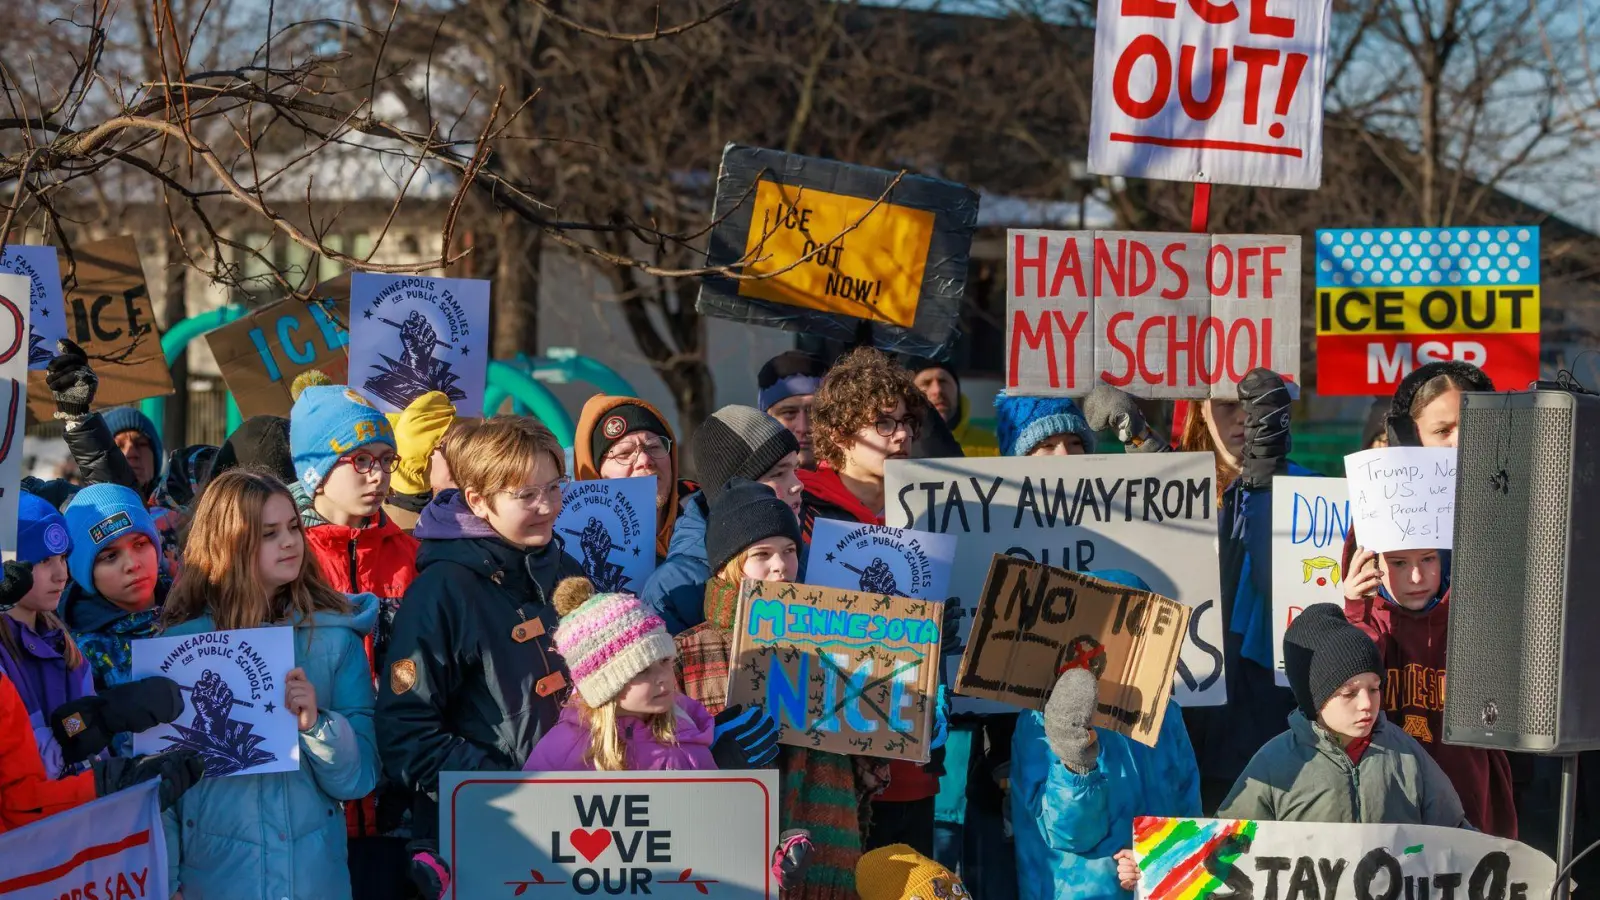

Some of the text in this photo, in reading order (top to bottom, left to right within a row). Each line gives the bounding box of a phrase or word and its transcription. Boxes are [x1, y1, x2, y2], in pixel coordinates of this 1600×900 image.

[1113, 34, 1308, 138] OUT!
[775, 203, 812, 233] ICE
[802, 240, 844, 268] OUT
[1015, 235, 1286, 300] HANDS OFF
[71, 285, 152, 344] ICE
[372, 279, 469, 336] MINNEAPOLIS FAMILIES
[825, 272, 881, 305] NOW!
[1320, 290, 1533, 331] ICE OUT
[248, 297, 349, 382] ICE
[407, 291, 438, 304] PUBLIC
[439, 302, 459, 343] SCHOOLS
[1009, 310, 1294, 388] MY SCHOOL
[1358, 457, 1424, 481] Trump,
[101, 518, 128, 535] news
[557, 484, 640, 537] NNEAPOLIS FAMILIES
[584, 496, 612, 507] PUBLIC
[613, 505, 631, 545] SCHOOLS
[897, 476, 1210, 533] STAY AWAY FROM
[1394, 516, 1440, 541] Yes!
[836, 525, 931, 588] MINNEAPOLIS FAMILIES
[873, 536, 904, 553] PUBLIC
[904, 551, 920, 594] SCHOOLS
[748, 598, 939, 644] MINNESOTA
[160, 633, 274, 692] MINNEAPOLIS FAMILIES
[197, 646, 234, 659] PUBLIC
[235, 655, 260, 700] SCHOOLS
[765, 651, 920, 734] NICE
[573, 795, 650, 827] WE
[105, 867, 148, 900] SAY
[572, 867, 653, 895] OUR
[1203, 833, 1349, 900] STAY
